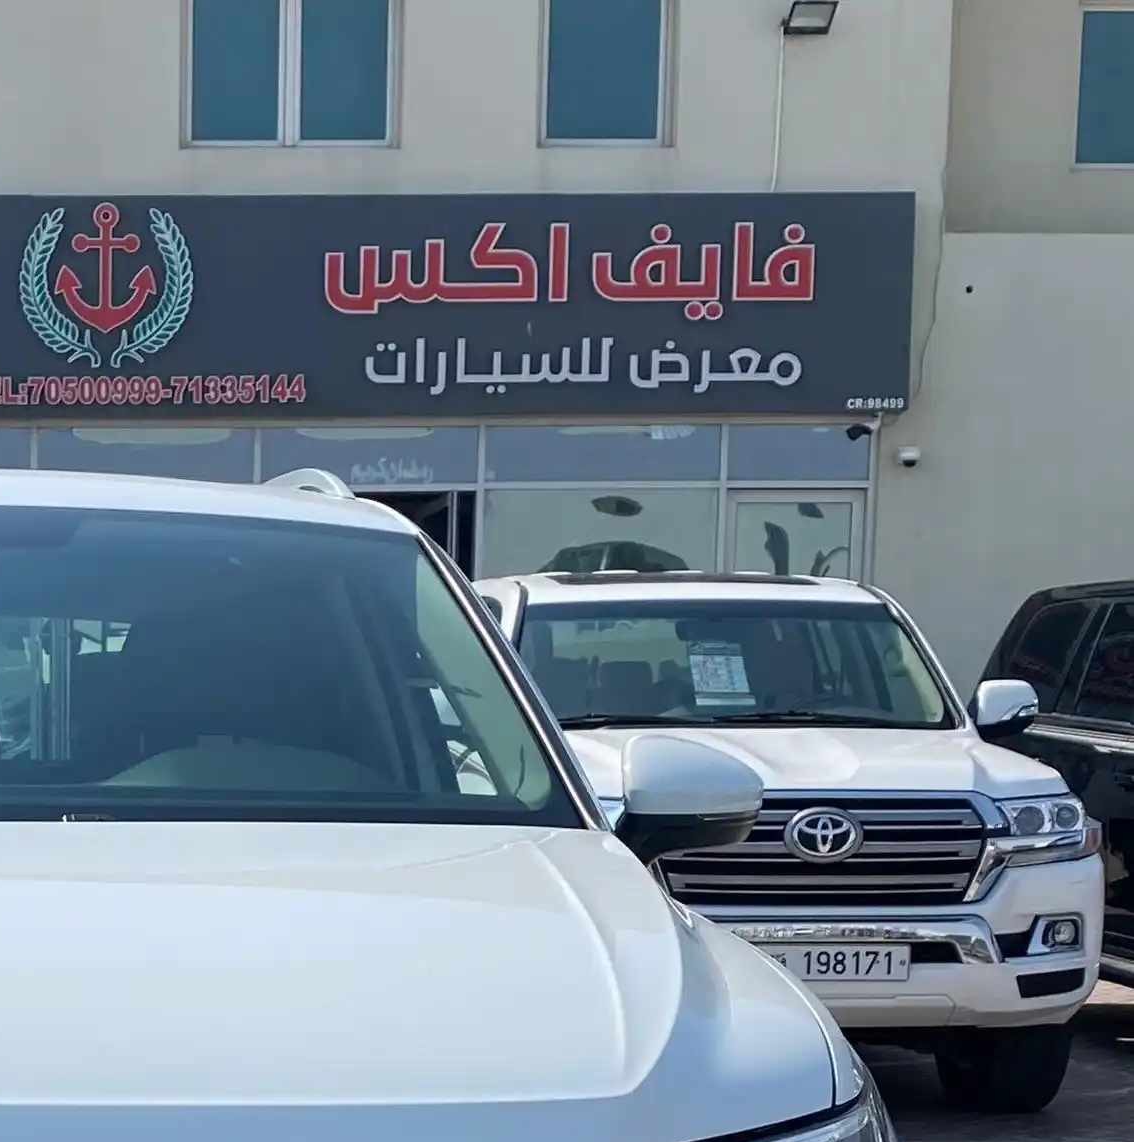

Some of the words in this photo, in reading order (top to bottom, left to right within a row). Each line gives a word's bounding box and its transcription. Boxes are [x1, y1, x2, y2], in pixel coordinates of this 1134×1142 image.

[325, 223, 569, 314] اكس
[592, 222, 815, 321] فايف
[365, 336, 614, 395] للسيارات
[629, 340, 802, 393] معرض
[802, 950, 894, 976] 198171
